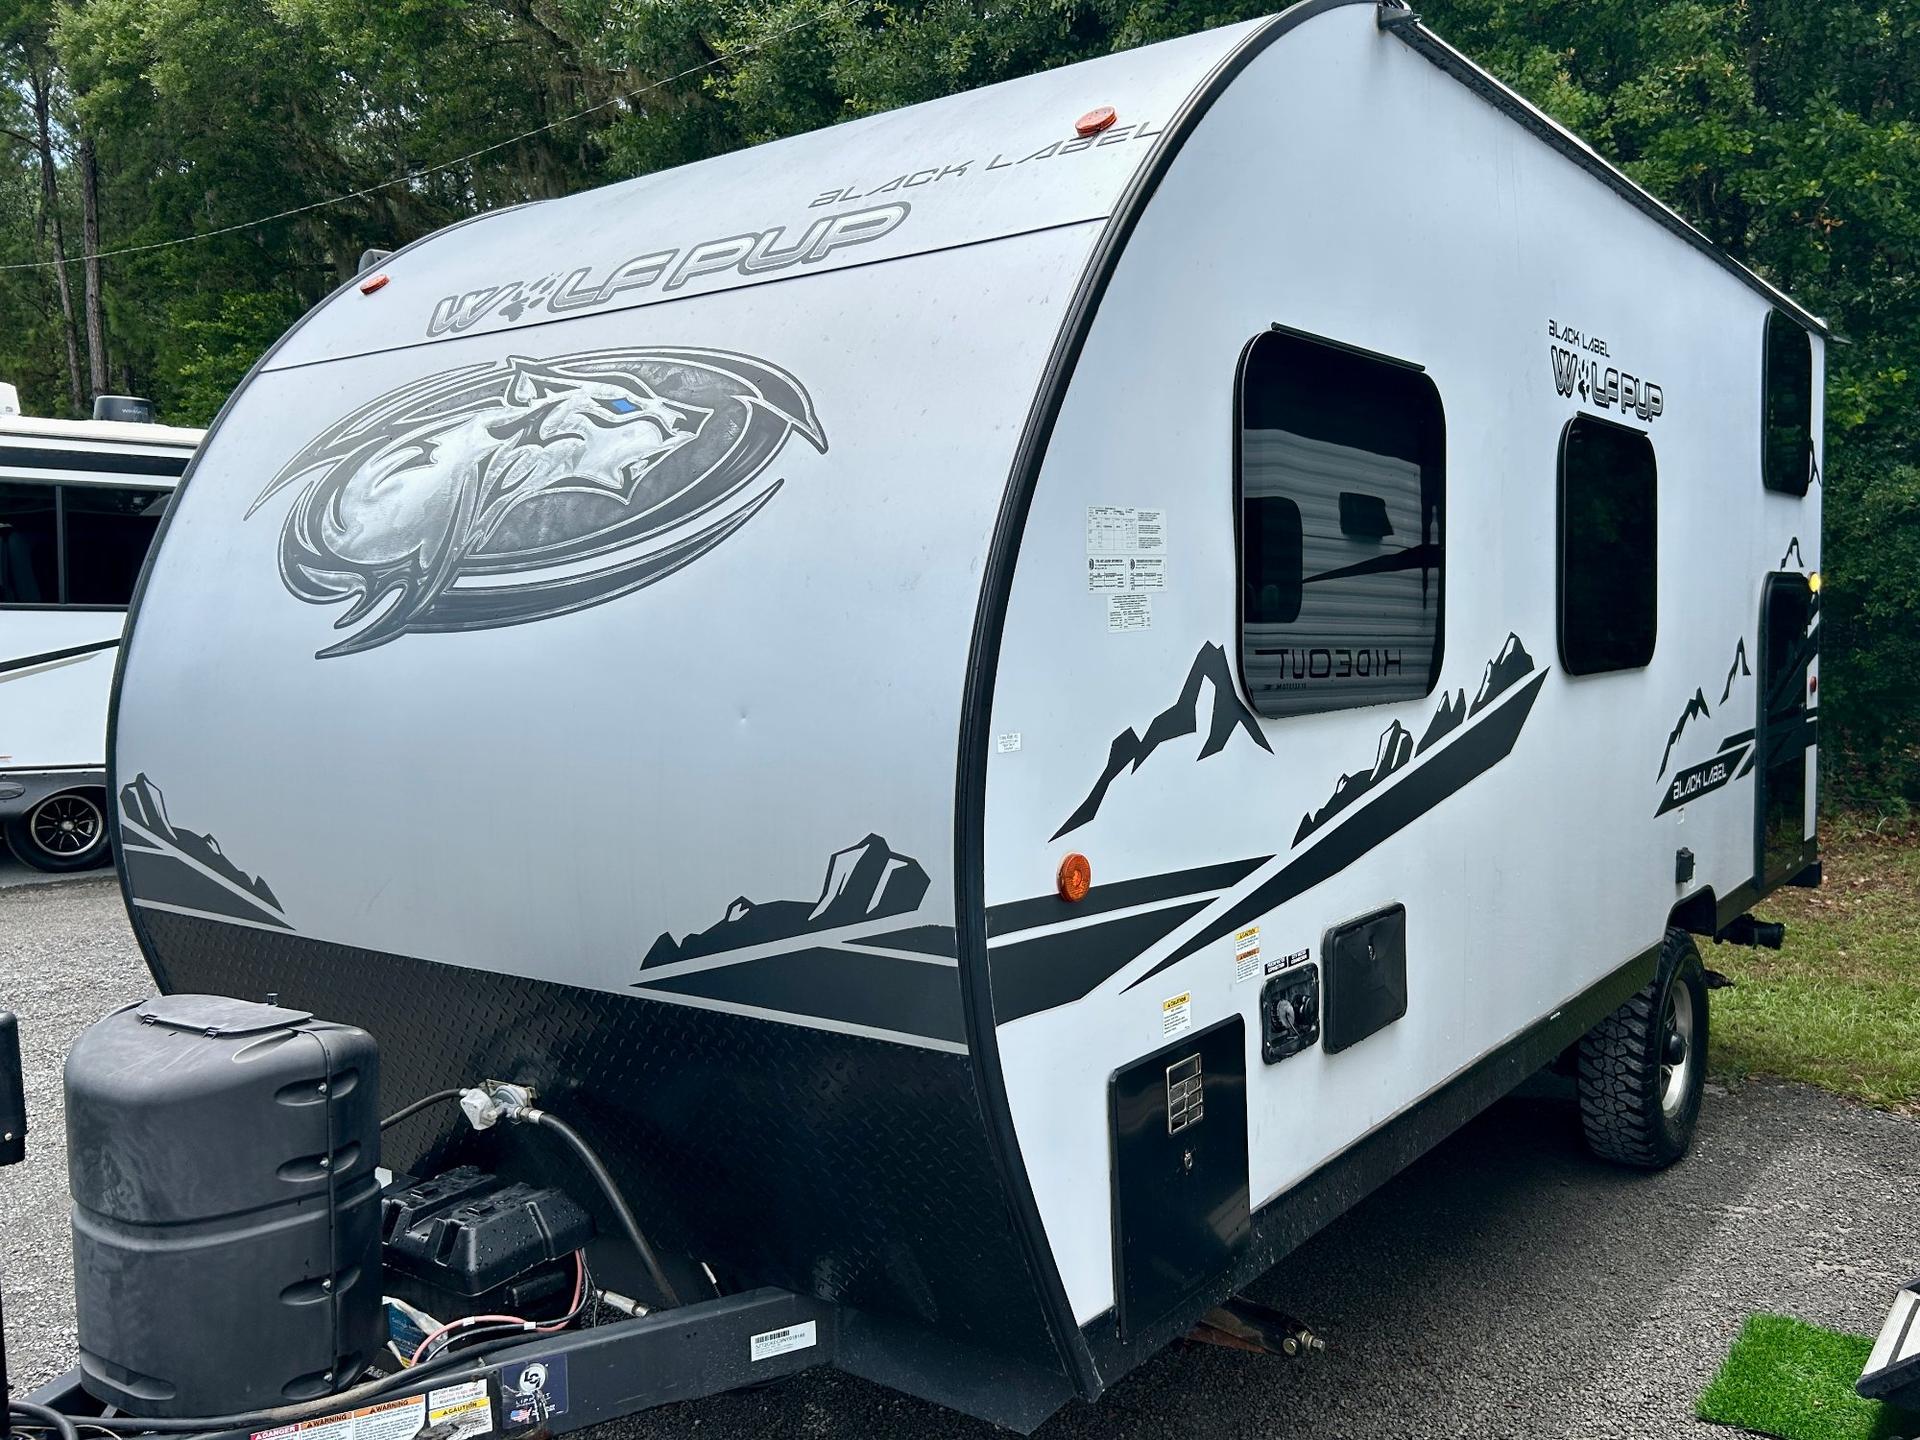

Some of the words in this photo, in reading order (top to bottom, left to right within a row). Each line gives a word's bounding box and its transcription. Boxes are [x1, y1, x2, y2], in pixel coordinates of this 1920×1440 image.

[808, 160, 975, 208] BLACK
[985, 120, 1164, 172] LABEL
[1548, 318, 1579, 347] BLACK
[1582, 332, 1611, 359] LABEL
[1672, 771, 1702, 800] BLACK
[1702, 762, 1727, 788] LABEL
[376, 1399, 409, 1413] WARNING
[448, 1401, 477, 1414] CAUTION
[312, 1413, 347, 1428] WARNING
[262, 1425, 296, 1439] DANGER
